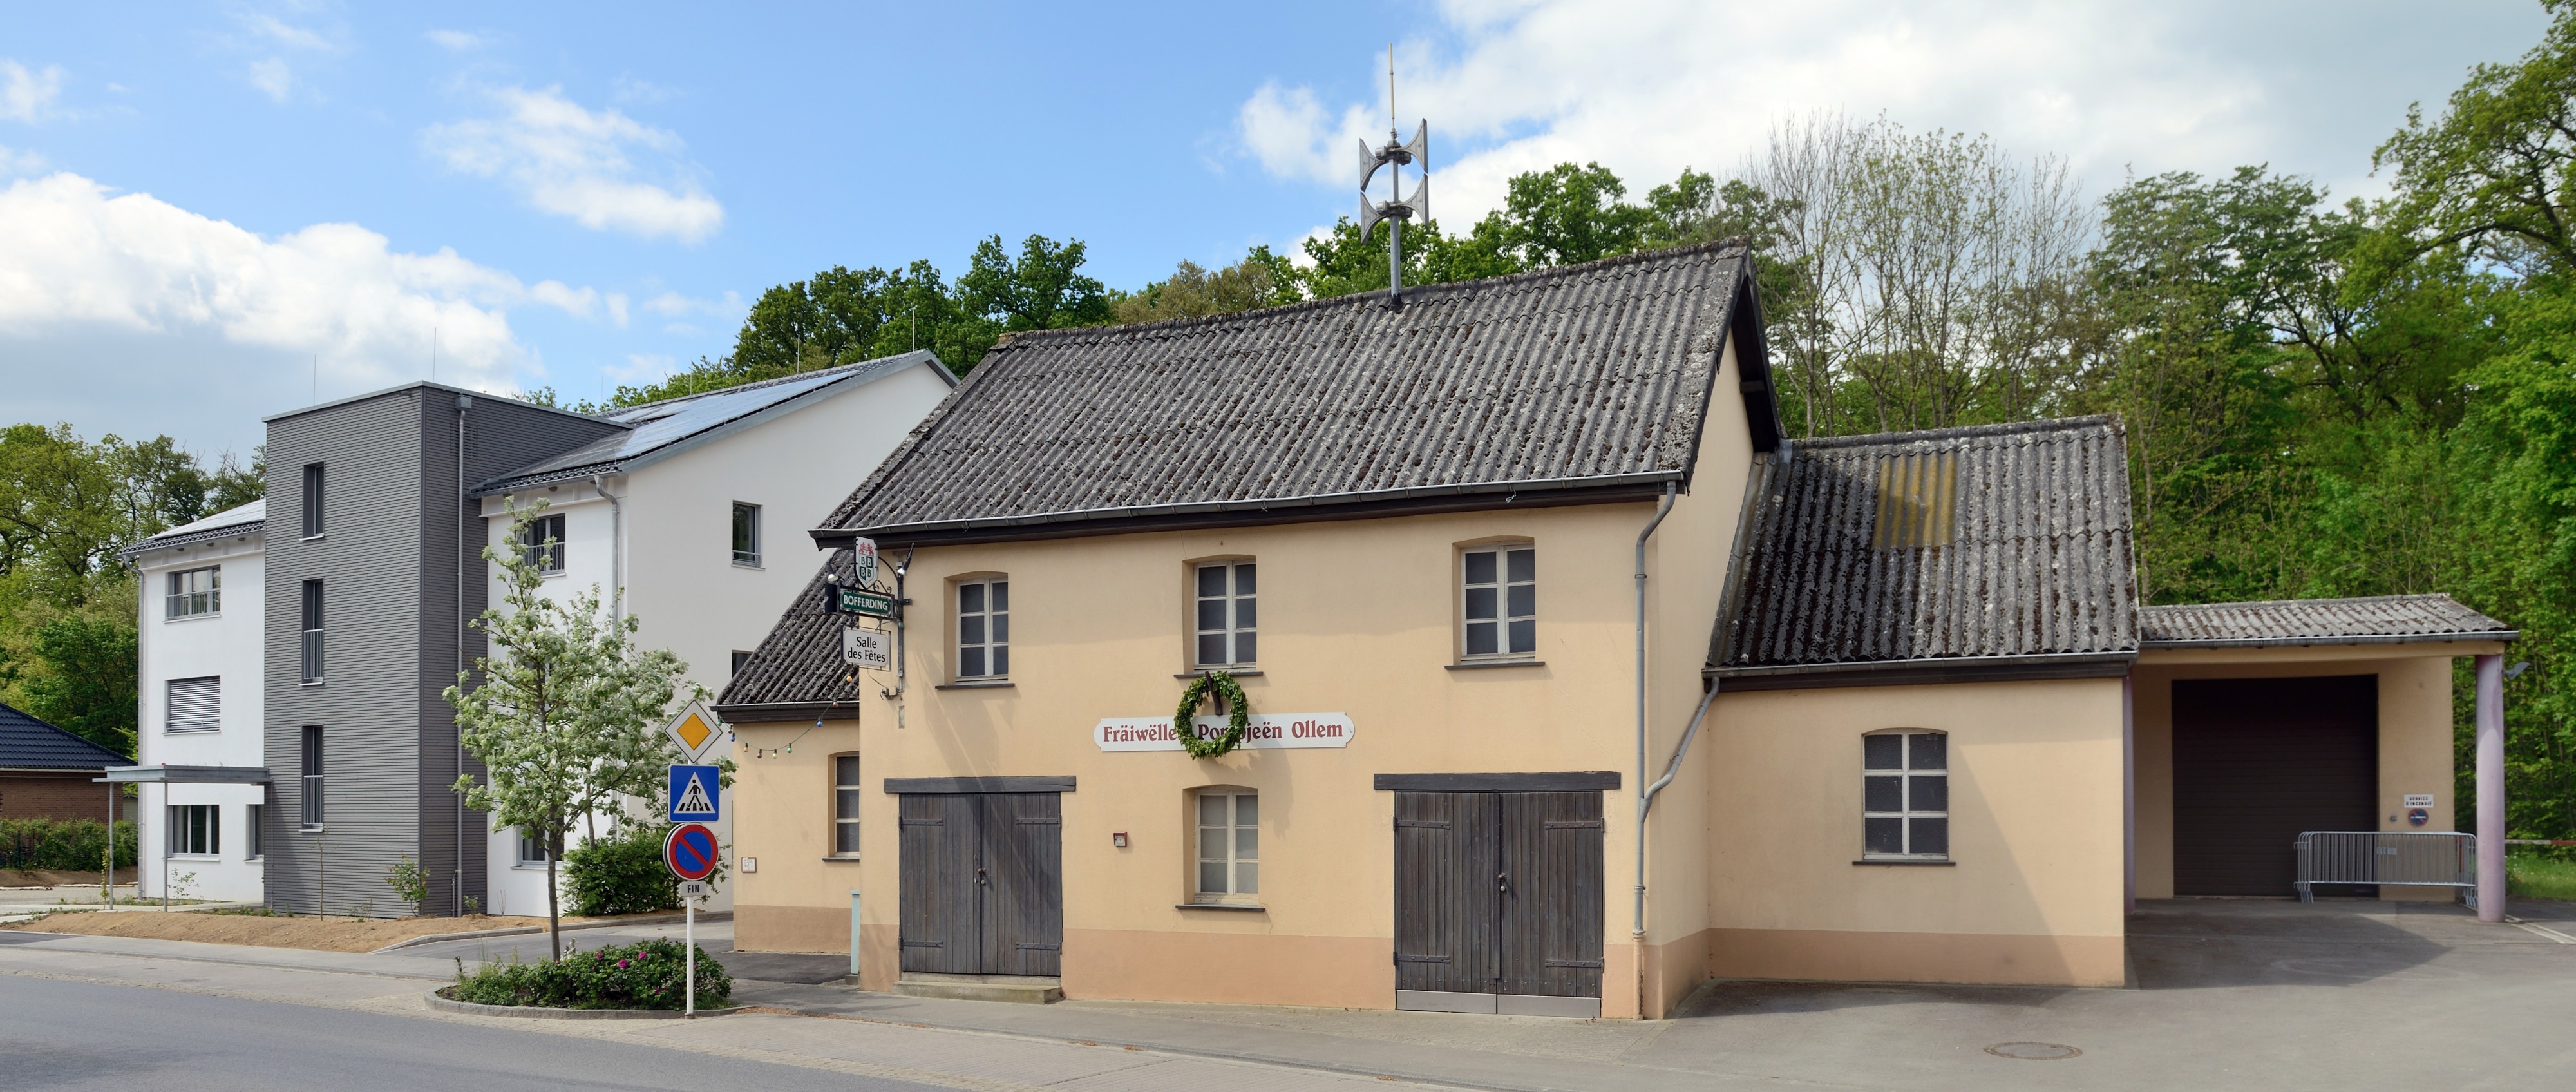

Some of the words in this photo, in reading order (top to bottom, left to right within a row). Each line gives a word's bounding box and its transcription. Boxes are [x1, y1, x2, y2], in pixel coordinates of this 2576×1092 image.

[861, 556, 866, 565] B
[867, 557, 872, 567] B
[861, 567, 866, 577] B
[867, 569, 871, 577] B
[843, 595, 888, 611] BOFFERDING
[856, 636, 876, 649] Salle
[848, 647, 862, 660] des
[865, 649, 886, 662] Fêtes
[1103, 723, 1177, 742] Fräiwëlle
[1291, 720, 1343, 738] Ollem
[687, 885, 700, 893] FIN
